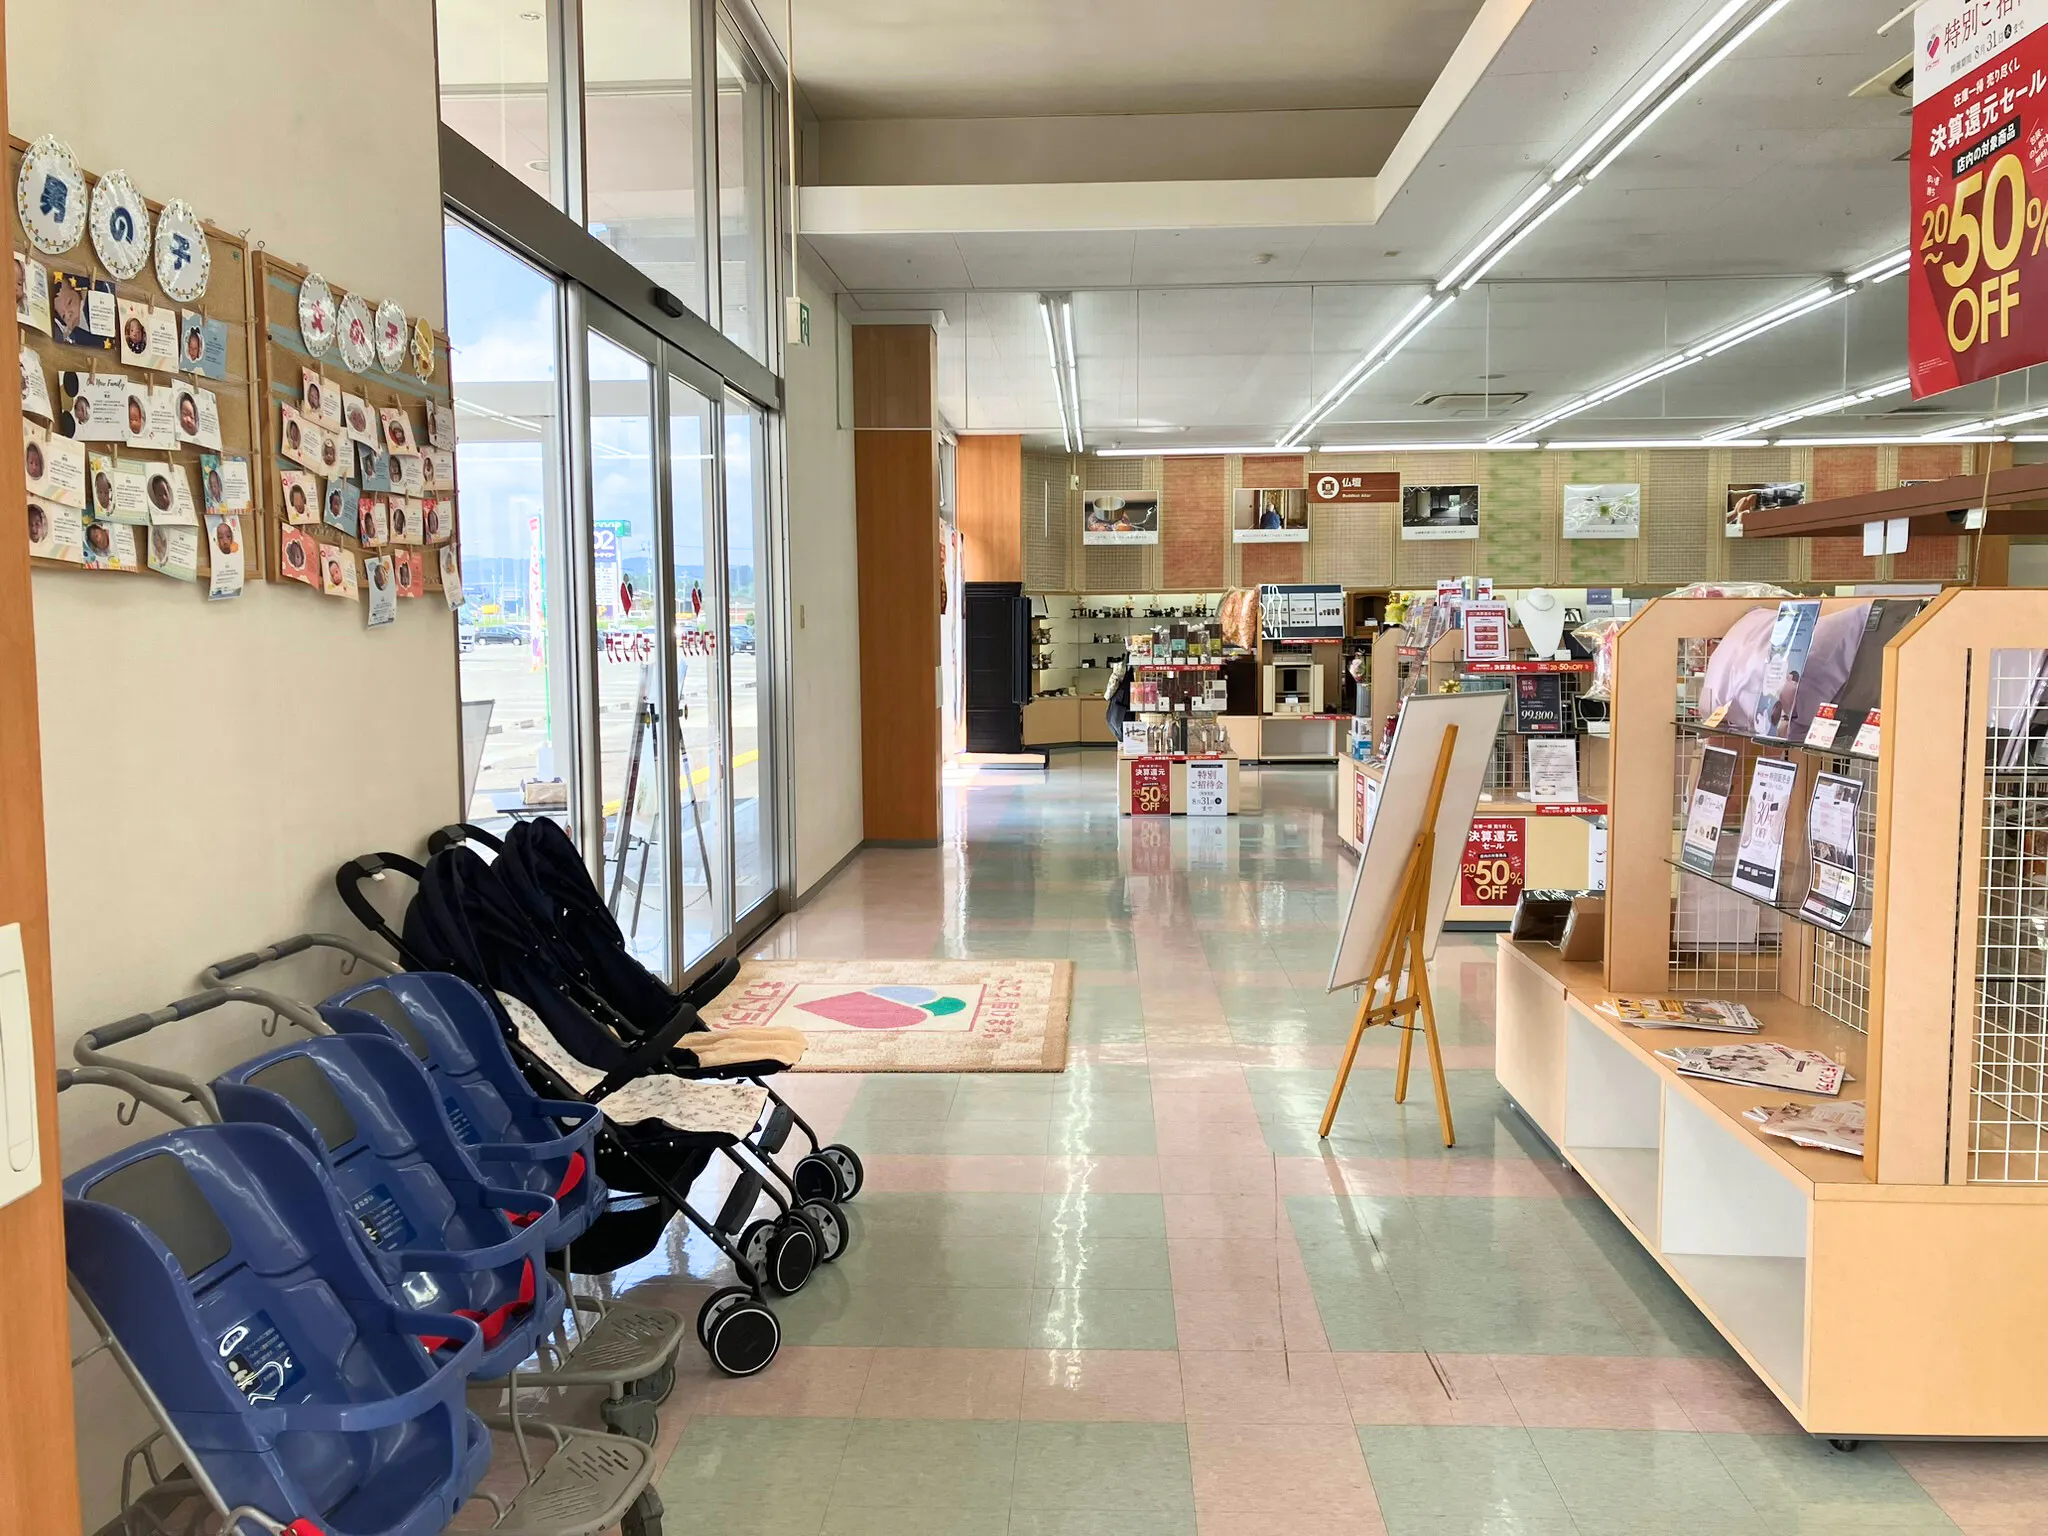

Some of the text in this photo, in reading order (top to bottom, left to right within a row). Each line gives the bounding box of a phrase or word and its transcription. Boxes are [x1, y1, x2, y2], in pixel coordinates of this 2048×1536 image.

[1929, 69, 2048, 158] 決算還元セール
[1956, 122, 2017, 174] 店内の対象商品
[1948, 268, 2020, 353] OFF
[1341, 477, 1362, 488] 仏壇
[1141, 802, 1160, 812] OFF
[1468, 830, 1518, 842] 決算還元
[1482, 842, 1505, 850] セール
[1476, 885, 1508, 900] OFF
